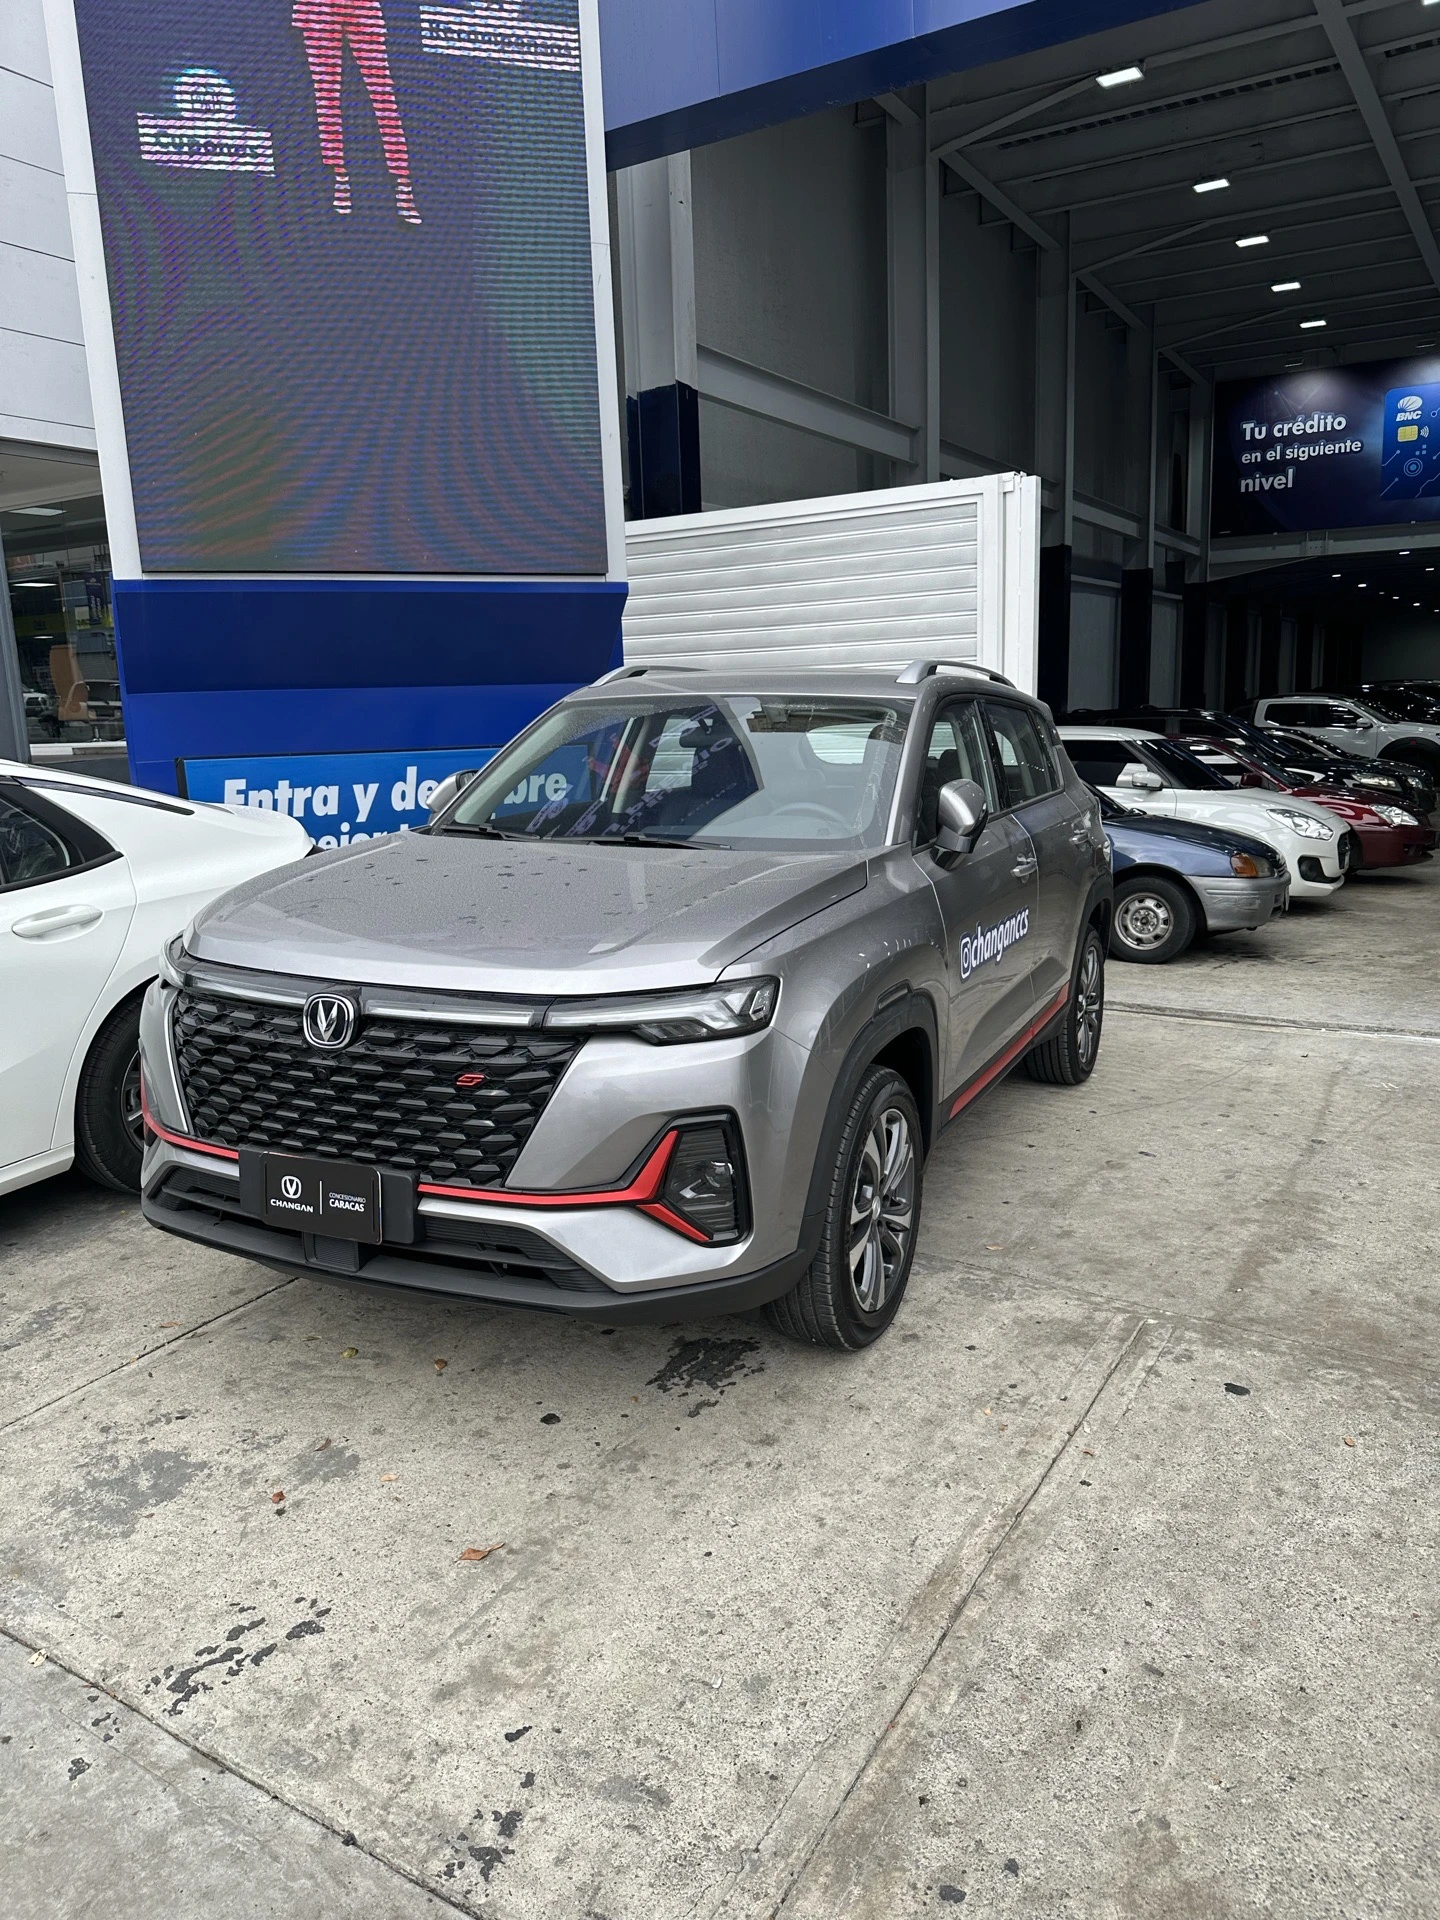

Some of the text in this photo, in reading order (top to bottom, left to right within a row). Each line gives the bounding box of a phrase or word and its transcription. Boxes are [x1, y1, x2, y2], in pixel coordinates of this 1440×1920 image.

[1395, 410, 1422, 422] BNC
[1242, 414, 1347, 441] Tu crédito
[1241, 439, 1362, 464] en el siguiente
[1240, 468, 1293, 493] nivel
[224, 779, 339, 817] Entra
[353, 784, 379, 822] y
[270, 1199, 314, 1213] CHANGAN
[329, 1192, 366, 1203] CONCESIONARIO
[329, 1199, 365, 1212] CARACAS
